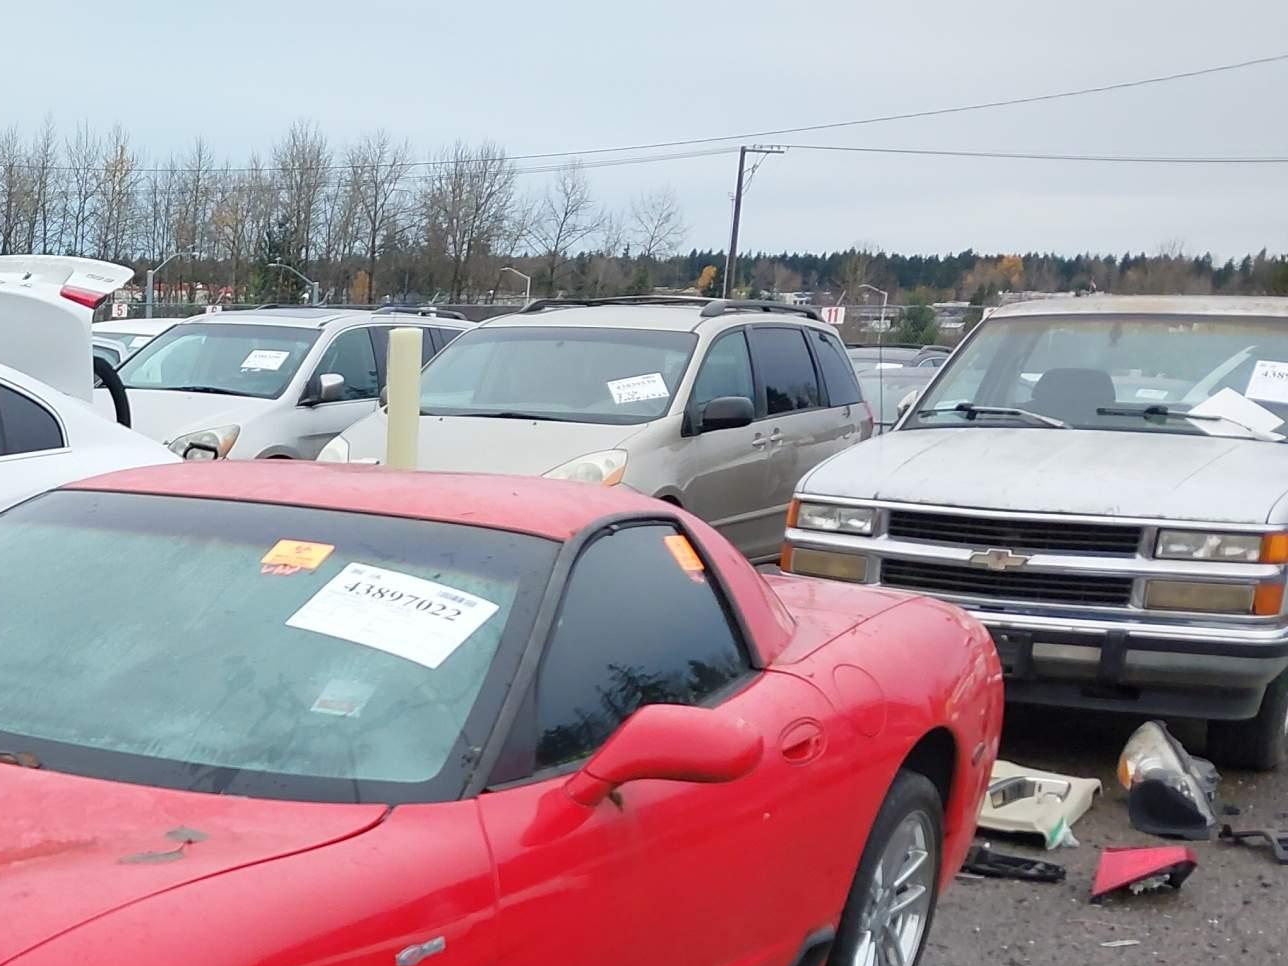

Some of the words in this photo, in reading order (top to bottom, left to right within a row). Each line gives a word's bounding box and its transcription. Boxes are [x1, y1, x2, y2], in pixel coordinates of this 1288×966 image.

[116, 304, 124, 316] 5
[826, 309, 839, 324] 11
[344, 581, 462, 622] 43897022
